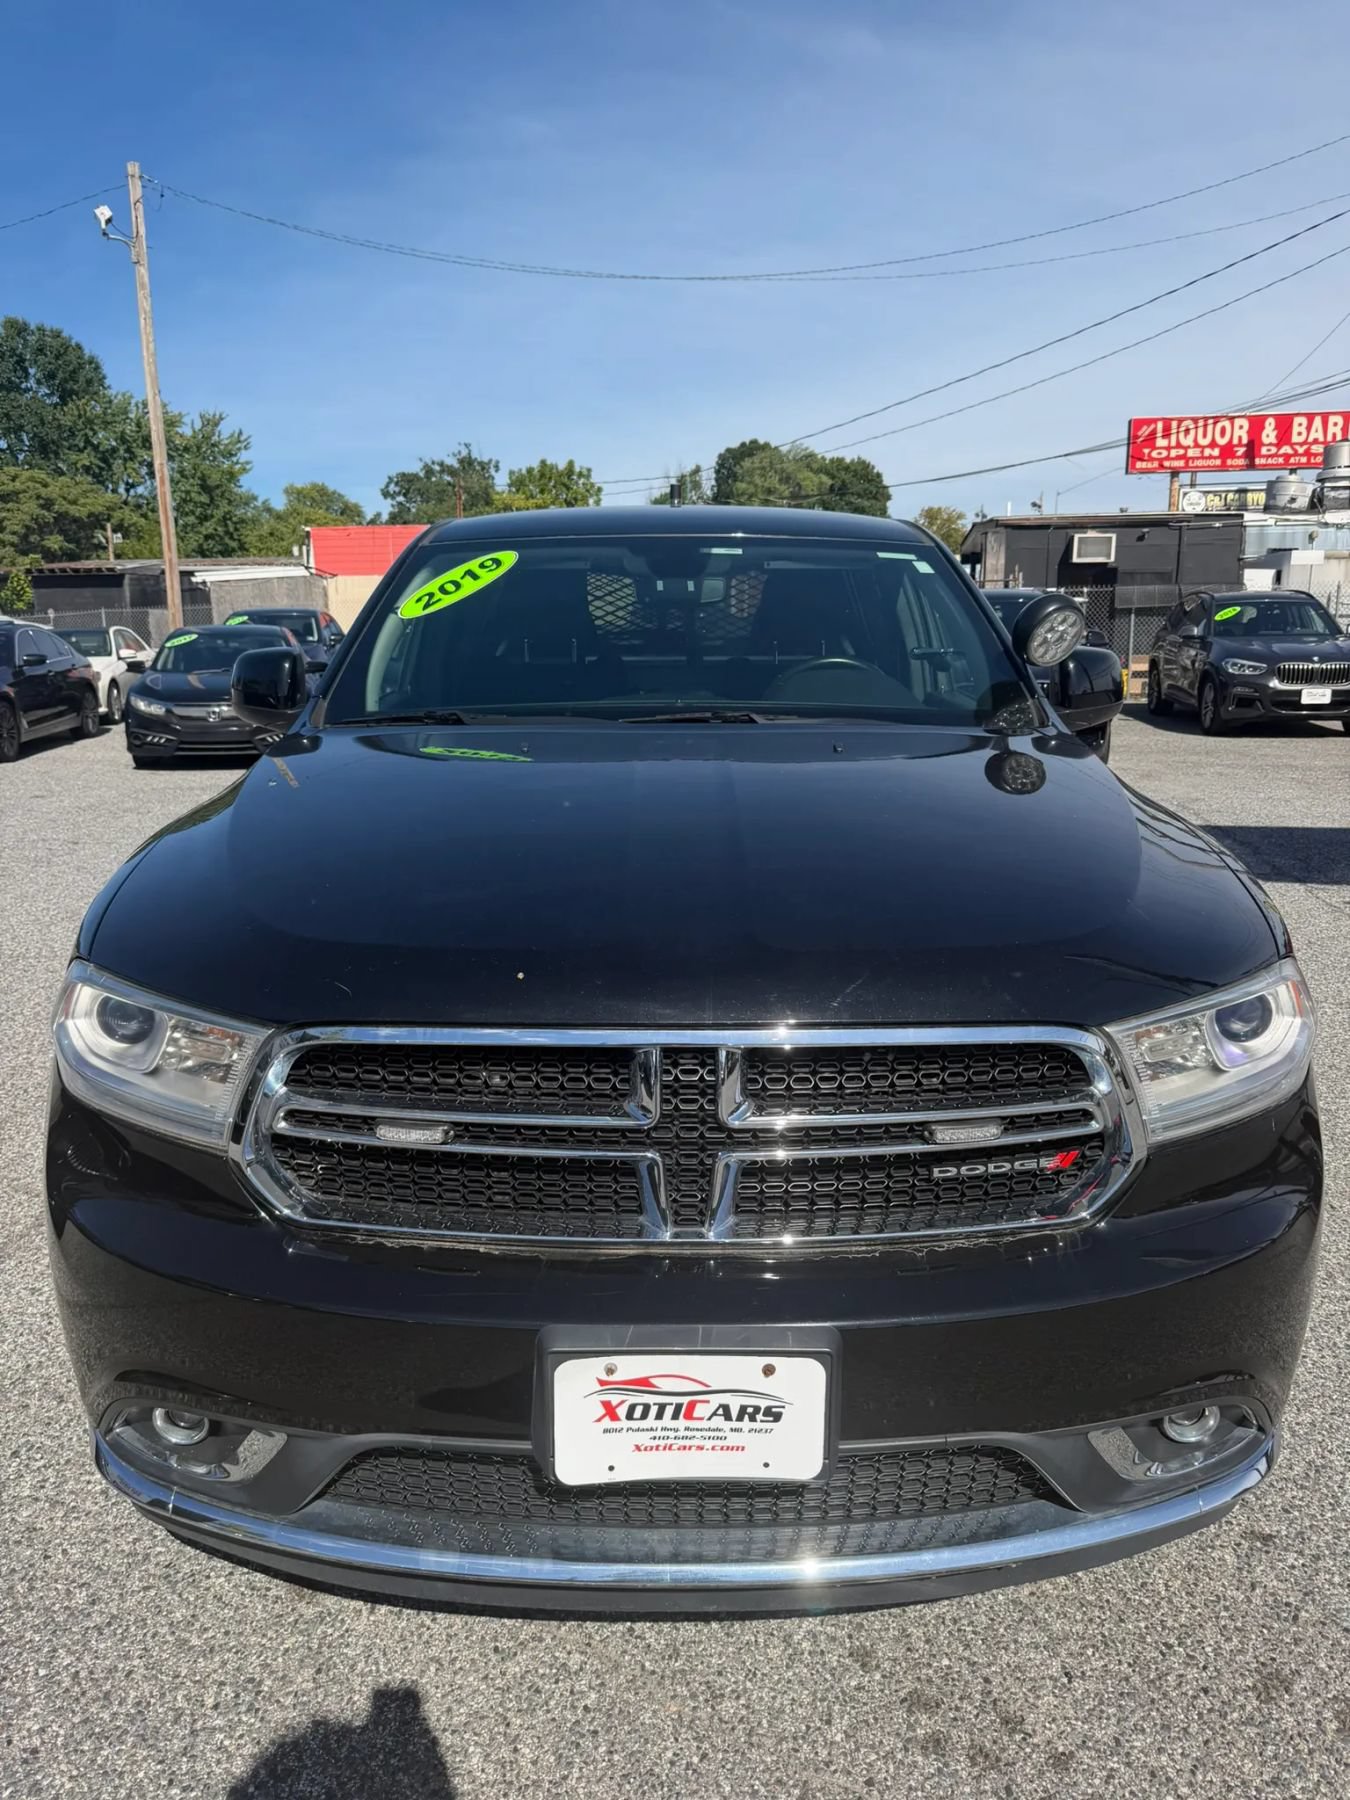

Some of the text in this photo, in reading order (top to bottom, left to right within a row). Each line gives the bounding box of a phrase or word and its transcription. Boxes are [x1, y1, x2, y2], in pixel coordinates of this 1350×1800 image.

[1155, 415, 1344, 448] LIQUOR & BAR
[1150, 444, 1324, 459] OPEN 7 DAYS
[1163, 459, 1185, 468] WINE
[1226, 458, 1250, 467] SODA
[1254, 456, 1285, 465] SNACK
[1289, 455, 1307, 464] ATM
[1311, 455, 1323, 464] LO
[415, 557, 503, 612] 2019
[932, 1158, 1059, 1178] DODGE
[626, 1425, 658, 1433] Pulaski
[747, 1427, 774, 1435] 21237
[632, 1442, 746, 1453] XotiCars.com
